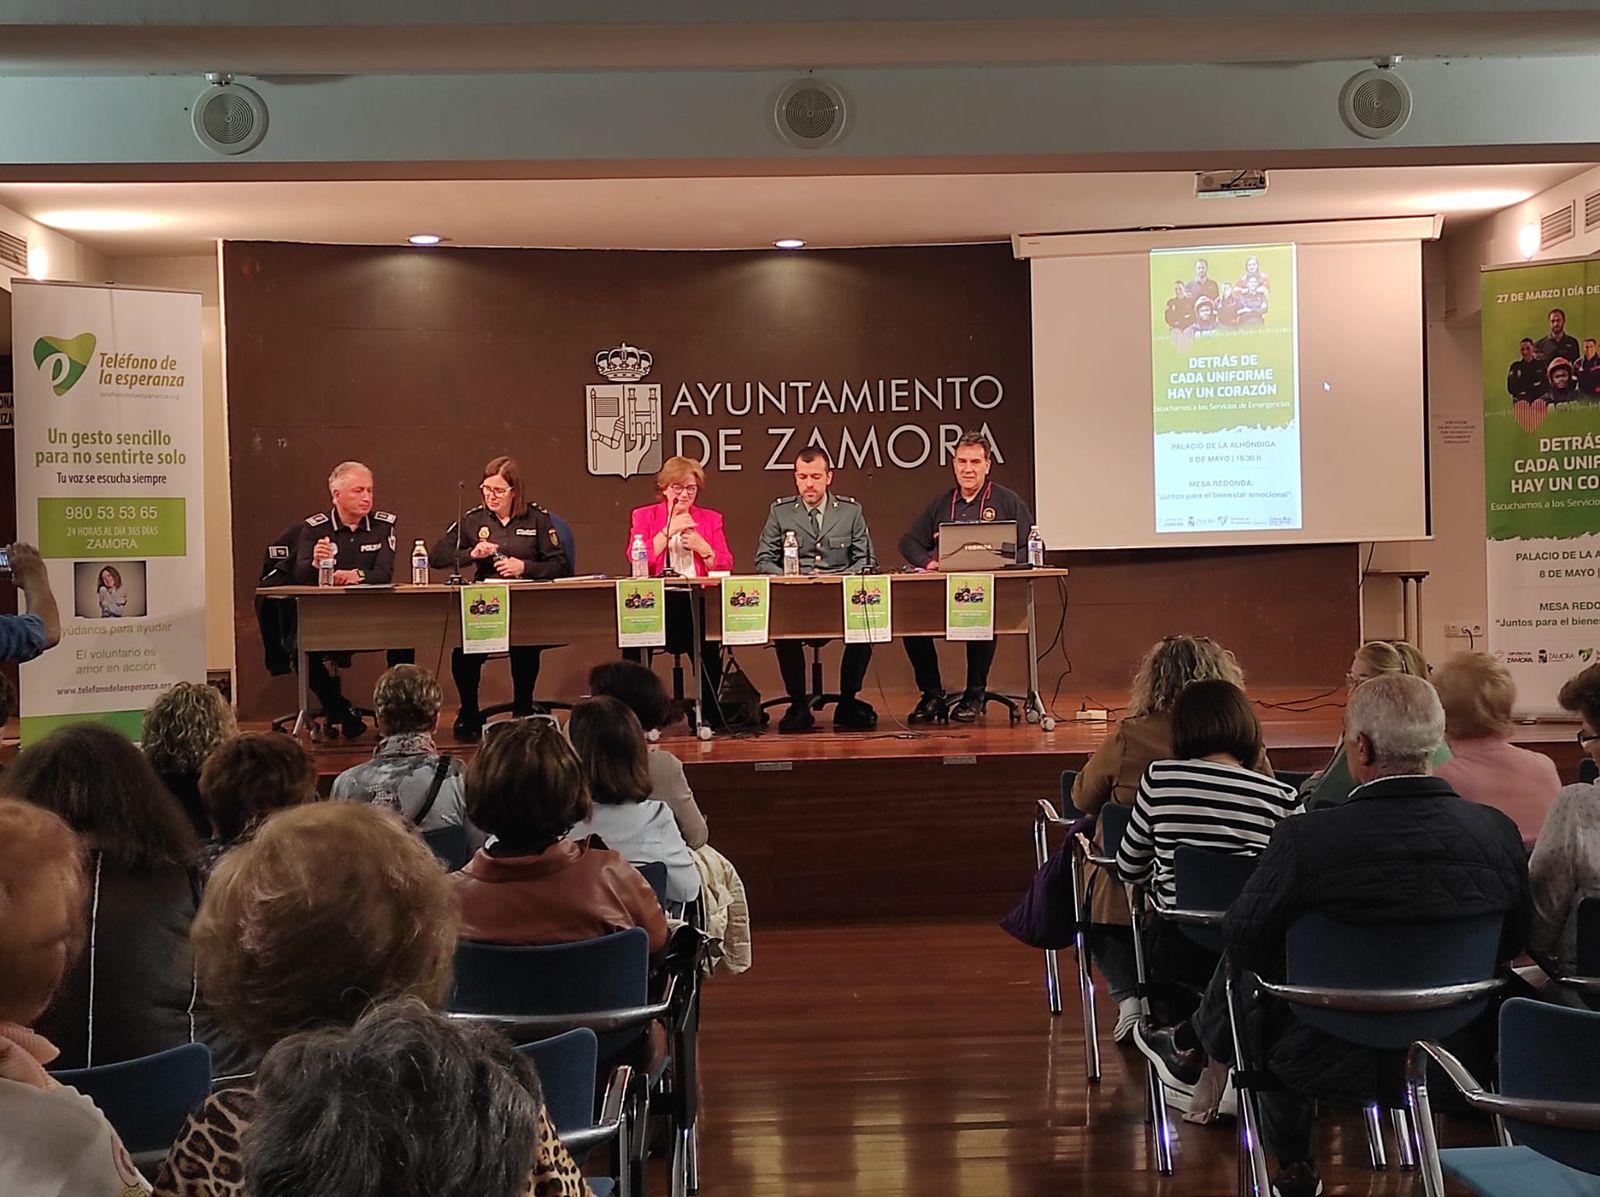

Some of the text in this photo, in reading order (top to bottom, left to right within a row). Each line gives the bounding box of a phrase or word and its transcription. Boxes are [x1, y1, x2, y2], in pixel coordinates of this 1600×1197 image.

[1496, 294, 1508, 303] 27
[1510, 292, 1524, 302] DE
[1526, 289, 1560, 300] MARZO
[1568, 286, 1584, 296] DÍA
[99, 353, 177, 370] Teléfono de
[1189, 354, 1258, 368] DETRÁS DE
[99, 370, 184, 389] la esperanza
[1170, 369, 1273, 384] CADA UNIFORME
[670, 375, 1003, 416] AYUNTAMIENTO
[1168, 382, 1276, 399] HAY UN CORAZÓN
[1248, 401, 1290, 410] Emergencias
[48, 428, 171, 448] Un gesto sencillo
[1172, 442, 1204, 450] PALACIO
[1230, 439, 1276, 448] ALHÓNDIGA
[1540, 432, 1600, 452] DETRÁS
[676, 422, 1004, 471] DE ZAMORA
[36, 449, 186, 468] para no sentirte solo
[1514, 458, 1559, 473] CADA
[57, 472, 167, 486] Tu voz se escucha siempre
[1511, 478, 1544, 494] HAY
[1549, 476, 1572, 491] UN
[1490, 502, 1542, 511] Escuchamos
[1552, 500, 1565, 508] los
[65, 506, 157, 520] 980 53 53 65
[67, 524, 158, 536] 24 HORAS AL DÍA 365 DÍAS
[87, 538, 138, 549] ZAMORA
[1516, 552, 1559, 561] PALACIO
[1562, 551, 1576, 559] DE
[1579, 550, 1592, 559] LA
[1539, 570, 1545, 578] 8
[1548, 570, 1562, 578] DE
[1565, 568, 1595, 577] MAYO
[1540, 602, 1569, 611] MESA
[1496, 618, 1533, 627] "Juntos
[1536, 619, 1557, 628] para
[62, 623, 172, 638] yúdanos para ayudar
[76, 648, 156, 660] El voluntario es
[76, 662, 156, 674] amor en acción
